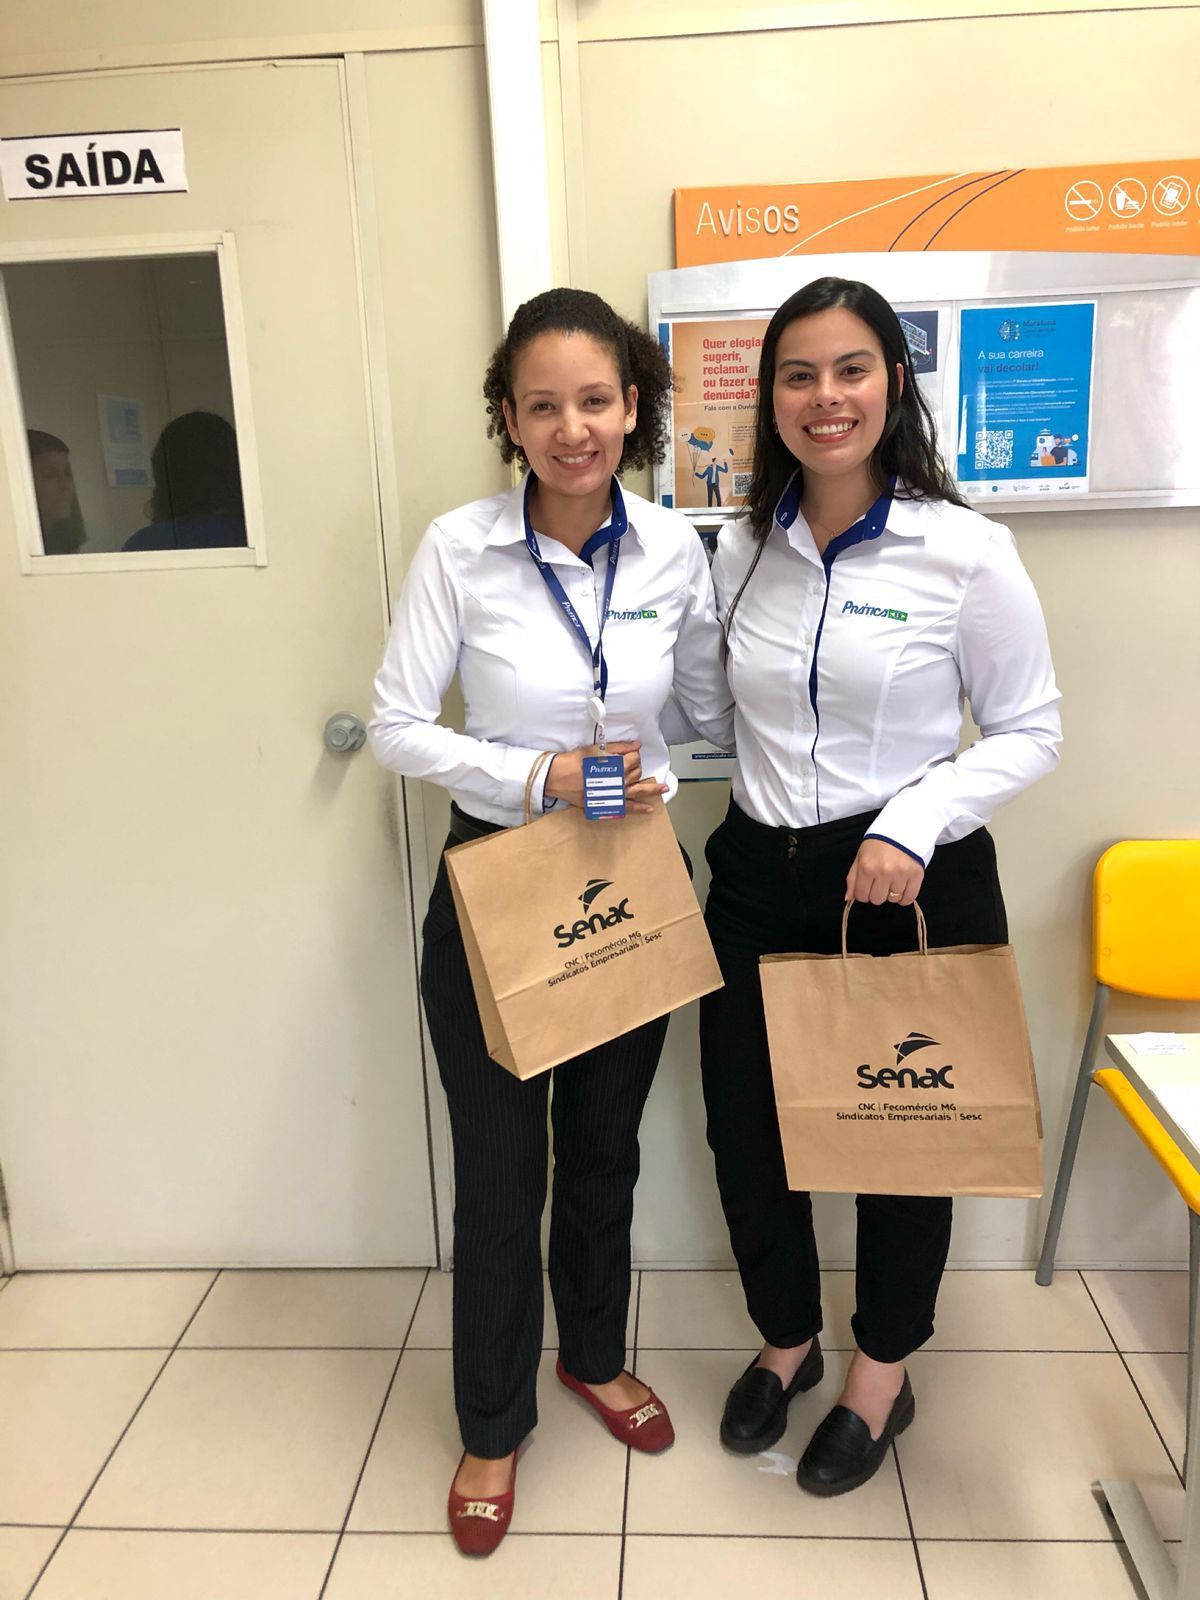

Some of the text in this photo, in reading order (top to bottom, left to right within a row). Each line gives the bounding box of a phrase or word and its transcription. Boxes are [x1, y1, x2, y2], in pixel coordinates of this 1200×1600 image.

[25, 142, 165, 190] SAÍDA
[696, 200, 800, 236] Avisos
[703, 338, 726, 349] Quer
[703, 351, 741, 363] sugerir,
[978, 348, 1044, 360] A sua carreira
[703, 365, 749, 375] reclamar
[703, 379, 716, 388] ou
[719, 377, 745, 387] fazer
[703, 389, 757, 400] denúncia?
[564, 958, 580, 969] CNC
[584, 937, 628, 960] Fecomércio
[628, 930, 642, 942] MG
[547, 965, 590, 987] Sindicatos
[590, 942, 640, 968] Empresariais
[644, 931, 663, 944] Sesc
[858, 1103, 876, 1111] CNC
[883, 1102, 938, 1111] Fecomércio
[941, 1103, 957, 1111] MG
[836, 1112, 885, 1121] Sindicatos
[887, 1113, 951, 1122] Empresariais
[959, 1113, 983, 1121] Sesc
